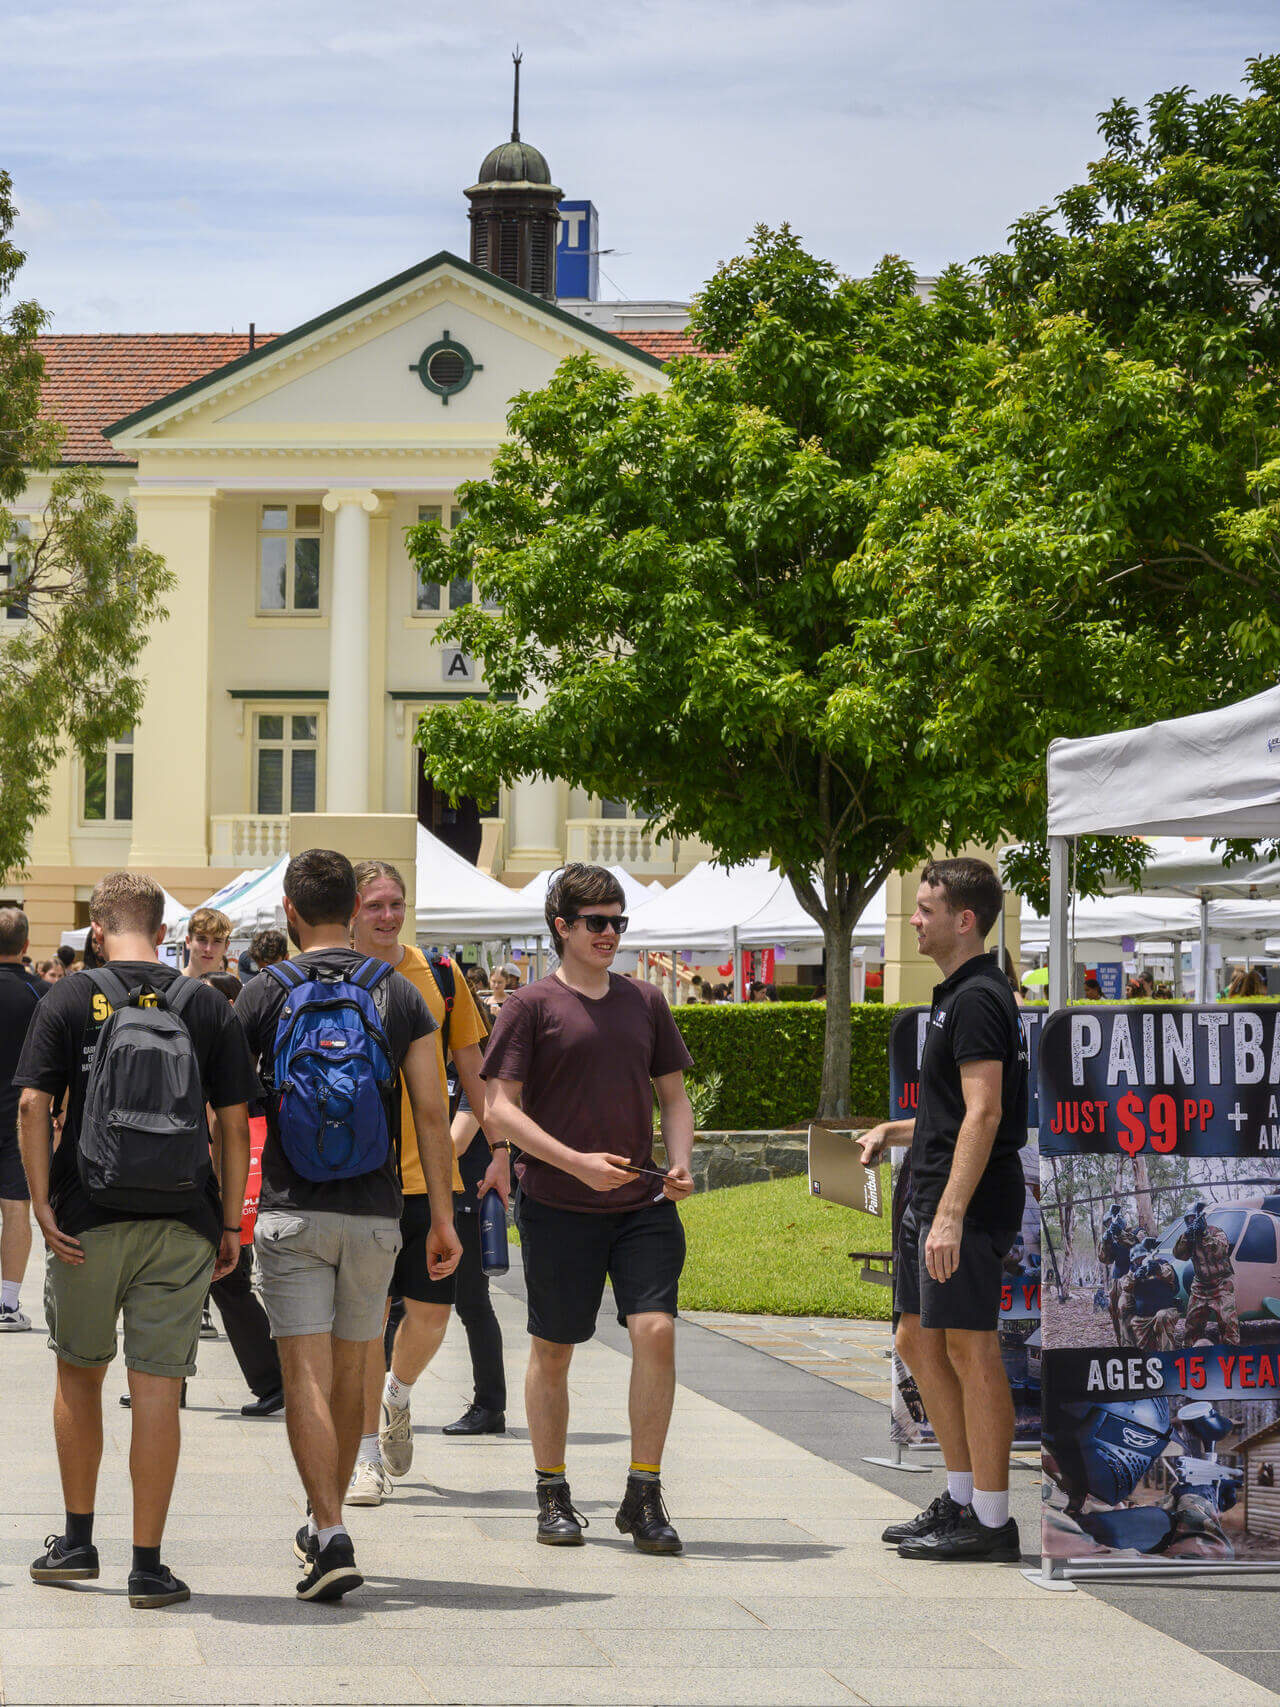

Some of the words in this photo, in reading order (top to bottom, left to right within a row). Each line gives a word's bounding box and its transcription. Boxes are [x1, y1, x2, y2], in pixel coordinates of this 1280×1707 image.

[557, 210, 586, 248] T
[448, 653, 469, 676] A
[898, 1083, 920, 1109] JU
[1050, 1101, 1109, 1134] JUST
[1116, 1090, 1178, 1158] $9
[1183, 1099, 1214, 1132] PP
[864, 1167, 879, 1215] Paintball
[1086, 1358, 1163, 1392] AGES
[1174, 1355, 1206, 1390] 15
[1216, 1354, 1280, 1389] YEA
